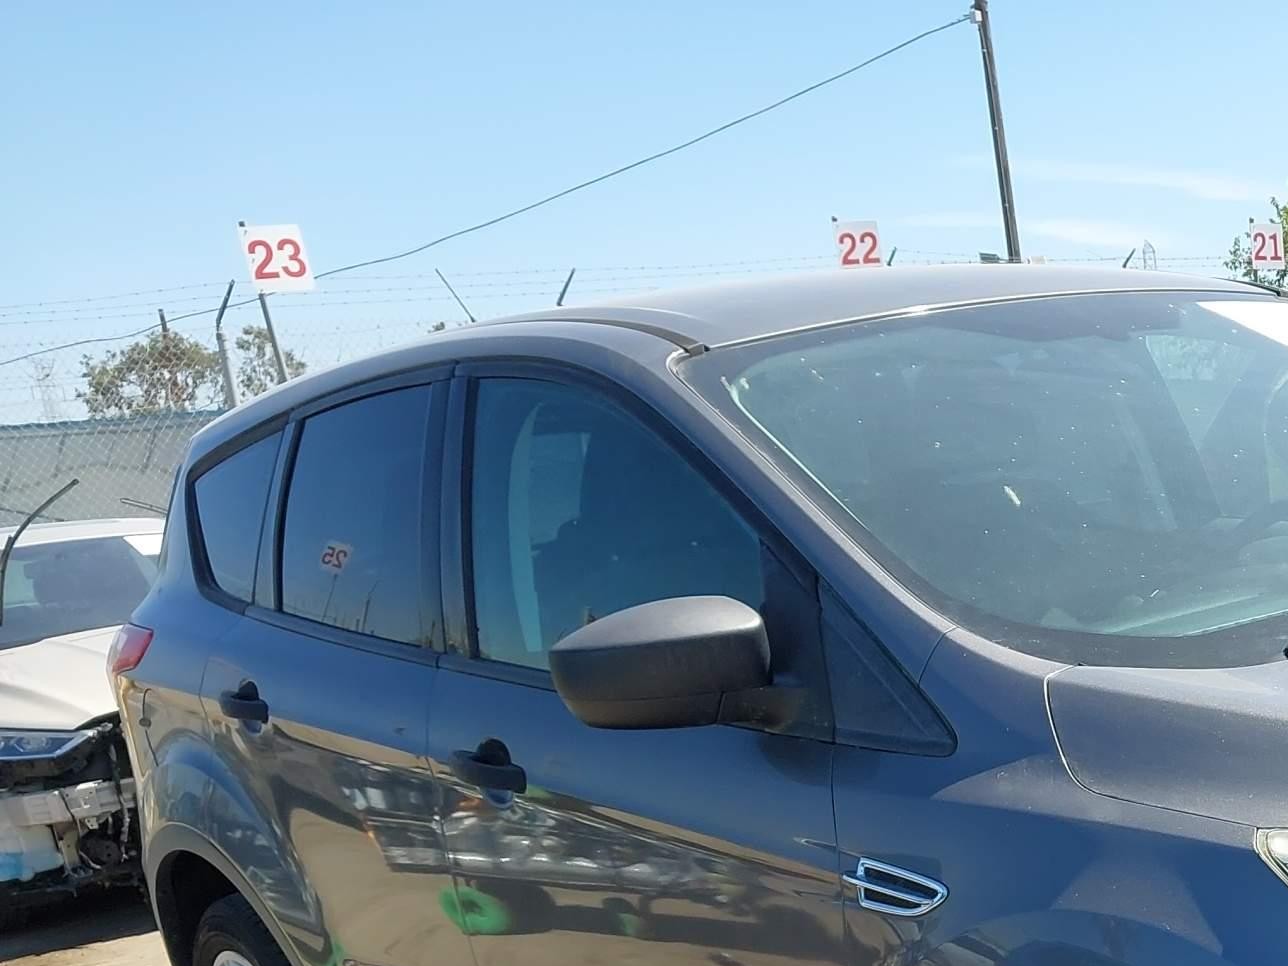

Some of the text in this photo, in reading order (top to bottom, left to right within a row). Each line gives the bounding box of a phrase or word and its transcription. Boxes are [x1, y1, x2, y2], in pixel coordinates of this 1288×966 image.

[247, 238, 307, 280] 23
[839, 231, 881, 266] 22
[1253, 232, 1283, 261] 21
